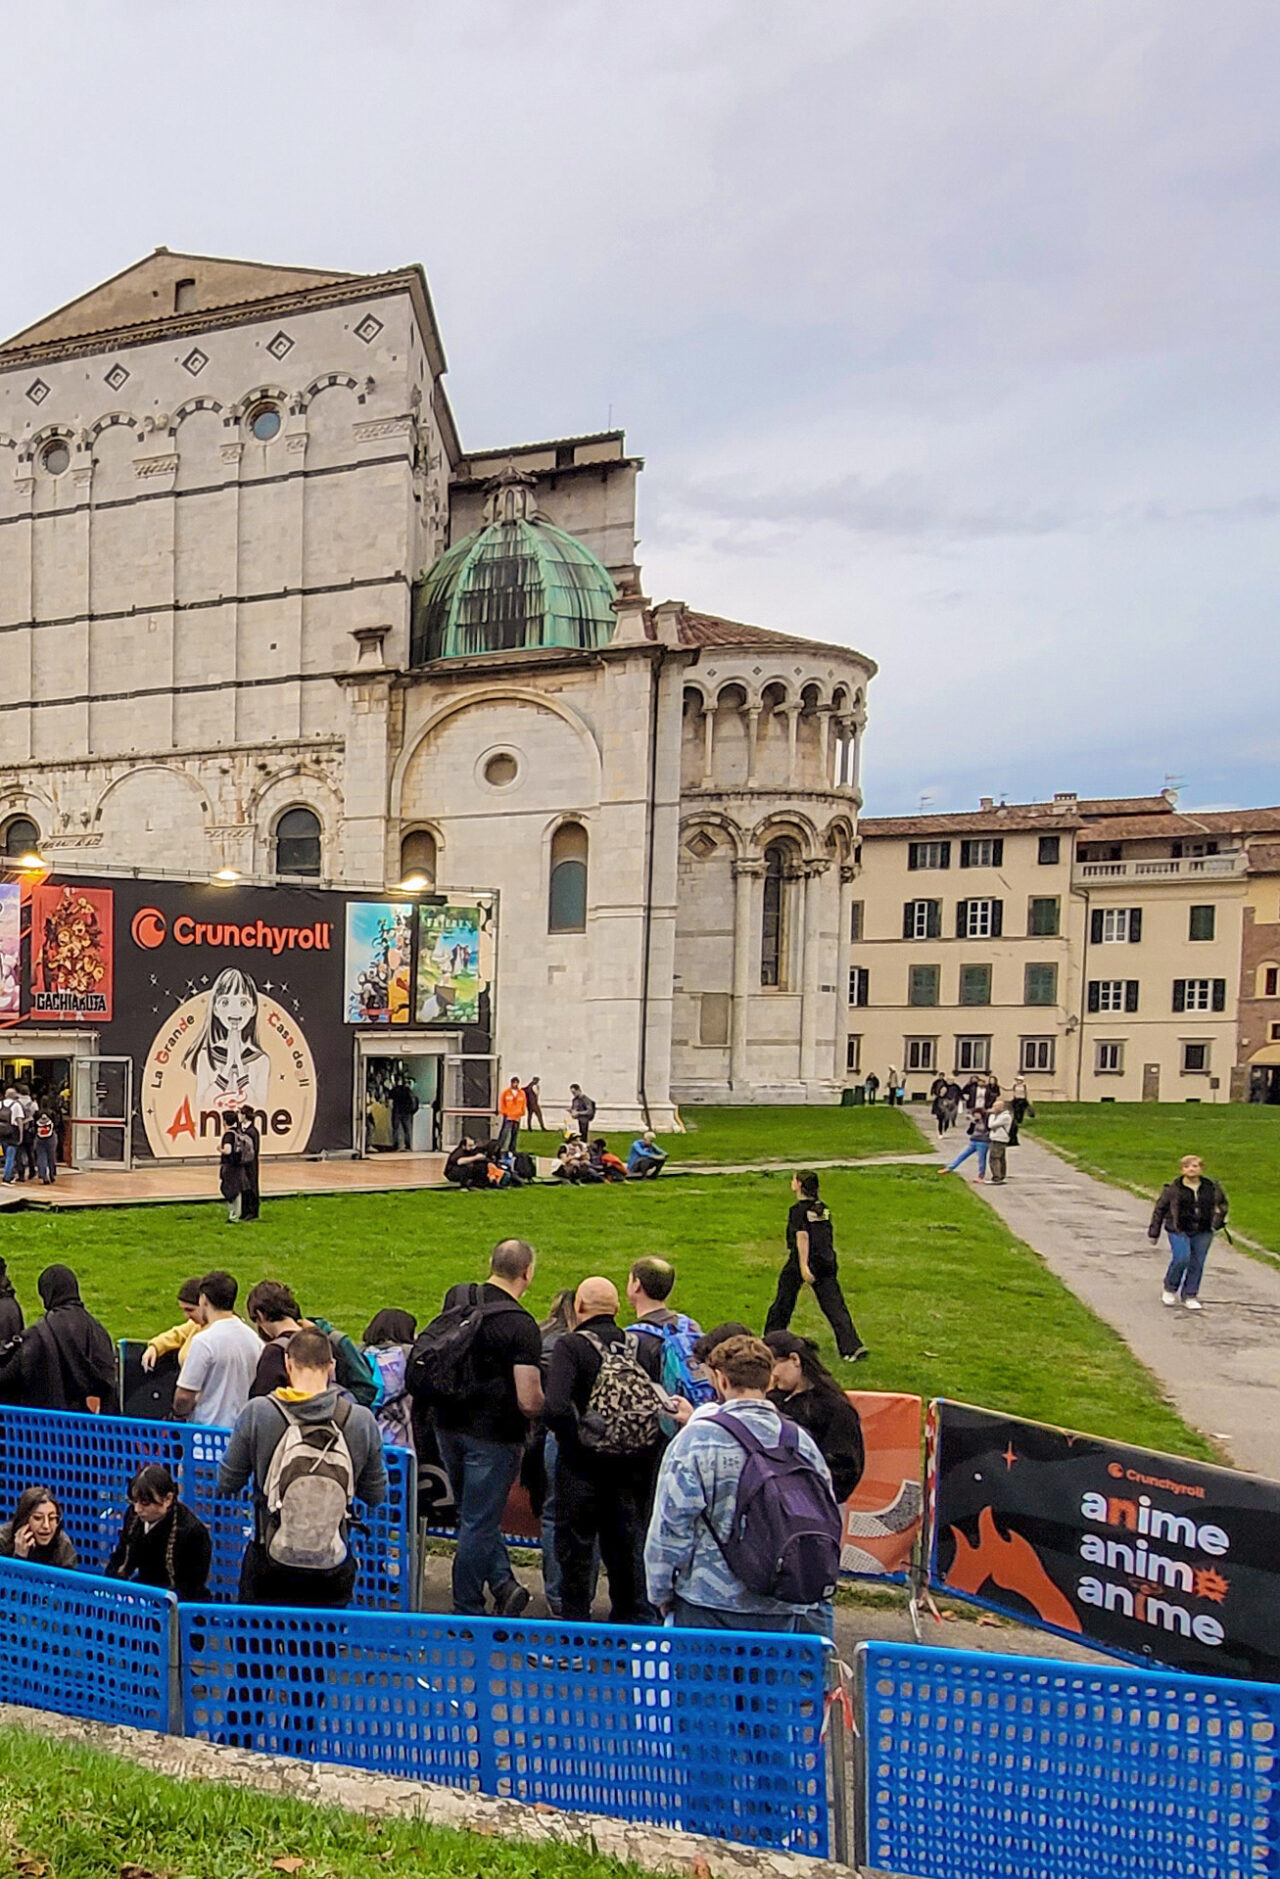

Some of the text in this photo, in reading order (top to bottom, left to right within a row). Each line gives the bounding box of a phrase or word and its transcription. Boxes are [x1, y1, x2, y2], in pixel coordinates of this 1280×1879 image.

[173, 916, 331, 955] Crunchyroll
[154, 1014, 195, 1065] Grande
[266, 1012, 295, 1047] Casa
[151, 1070, 163, 1089] La
[166, 1094, 293, 1142] Ane
[1125, 1468, 1206, 1499] Crunchyroll
[1080, 1490, 1231, 1557] anime
[1079, 1531, 1232, 1606] anime
[1077, 1574, 1226, 1648] anime
